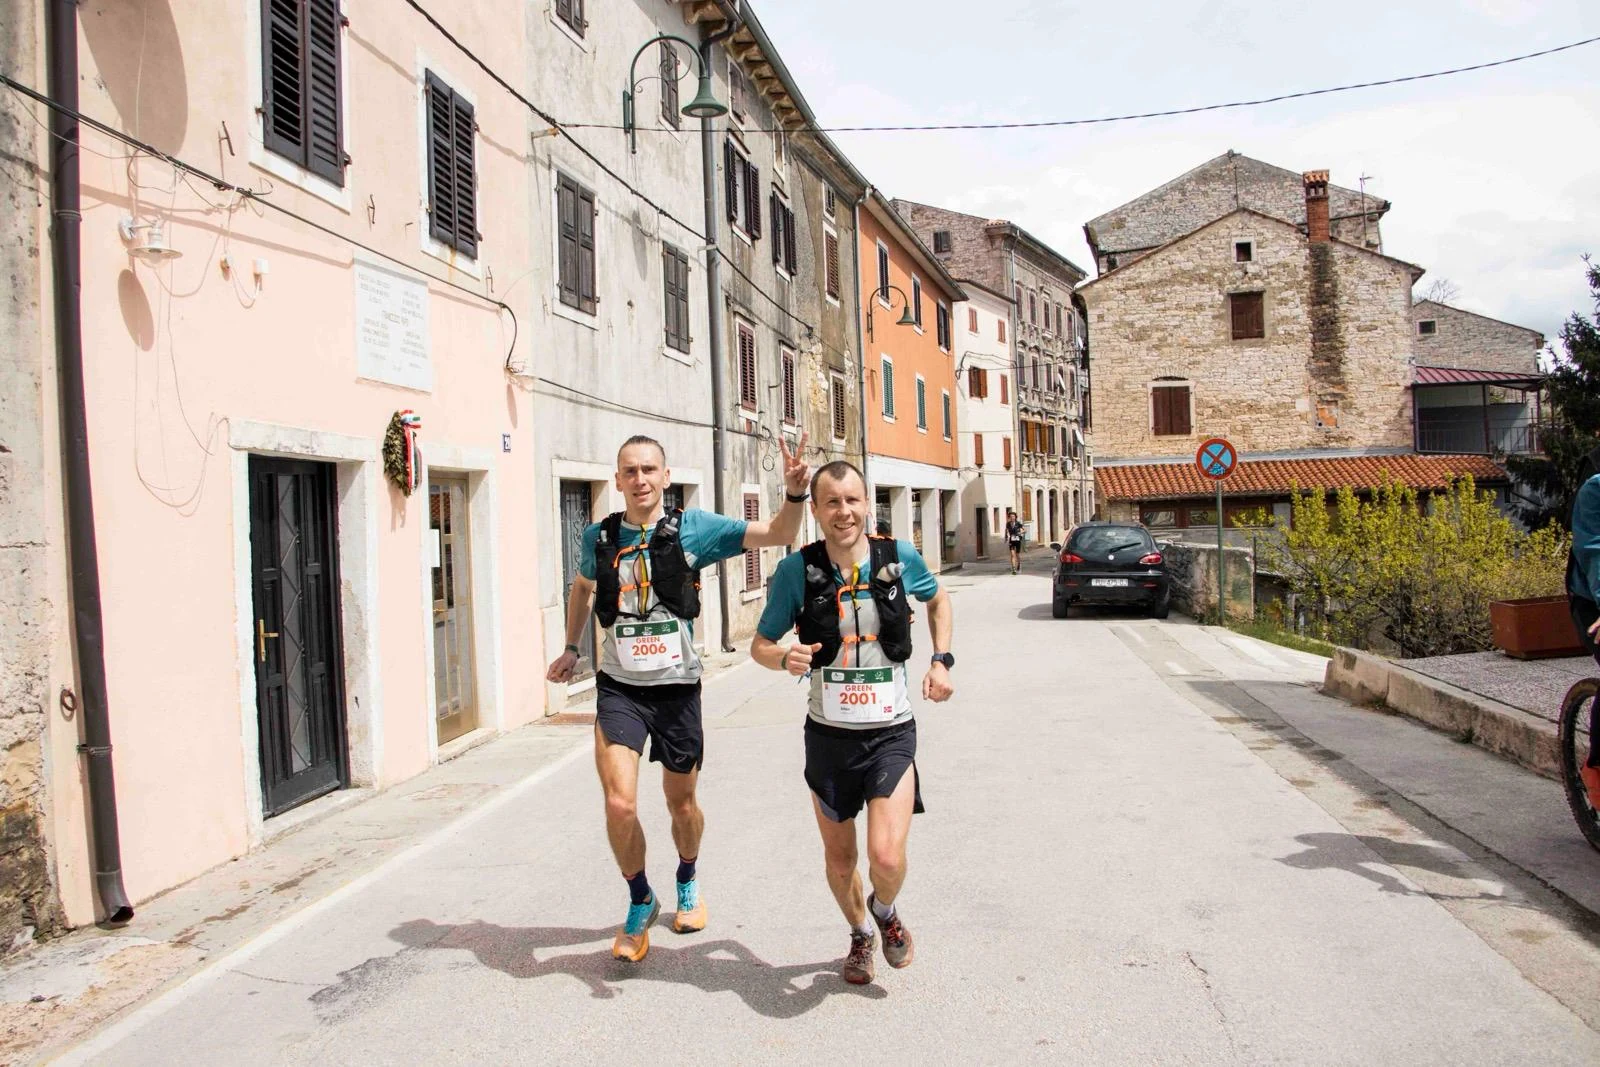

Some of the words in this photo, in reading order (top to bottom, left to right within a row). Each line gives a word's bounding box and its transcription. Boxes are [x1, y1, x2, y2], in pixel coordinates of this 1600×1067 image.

[636, 636, 661, 644] GREEN
[632, 643, 667, 656] 2006
[845, 684, 873, 692] GREEN
[840, 692, 876, 705] 2001
